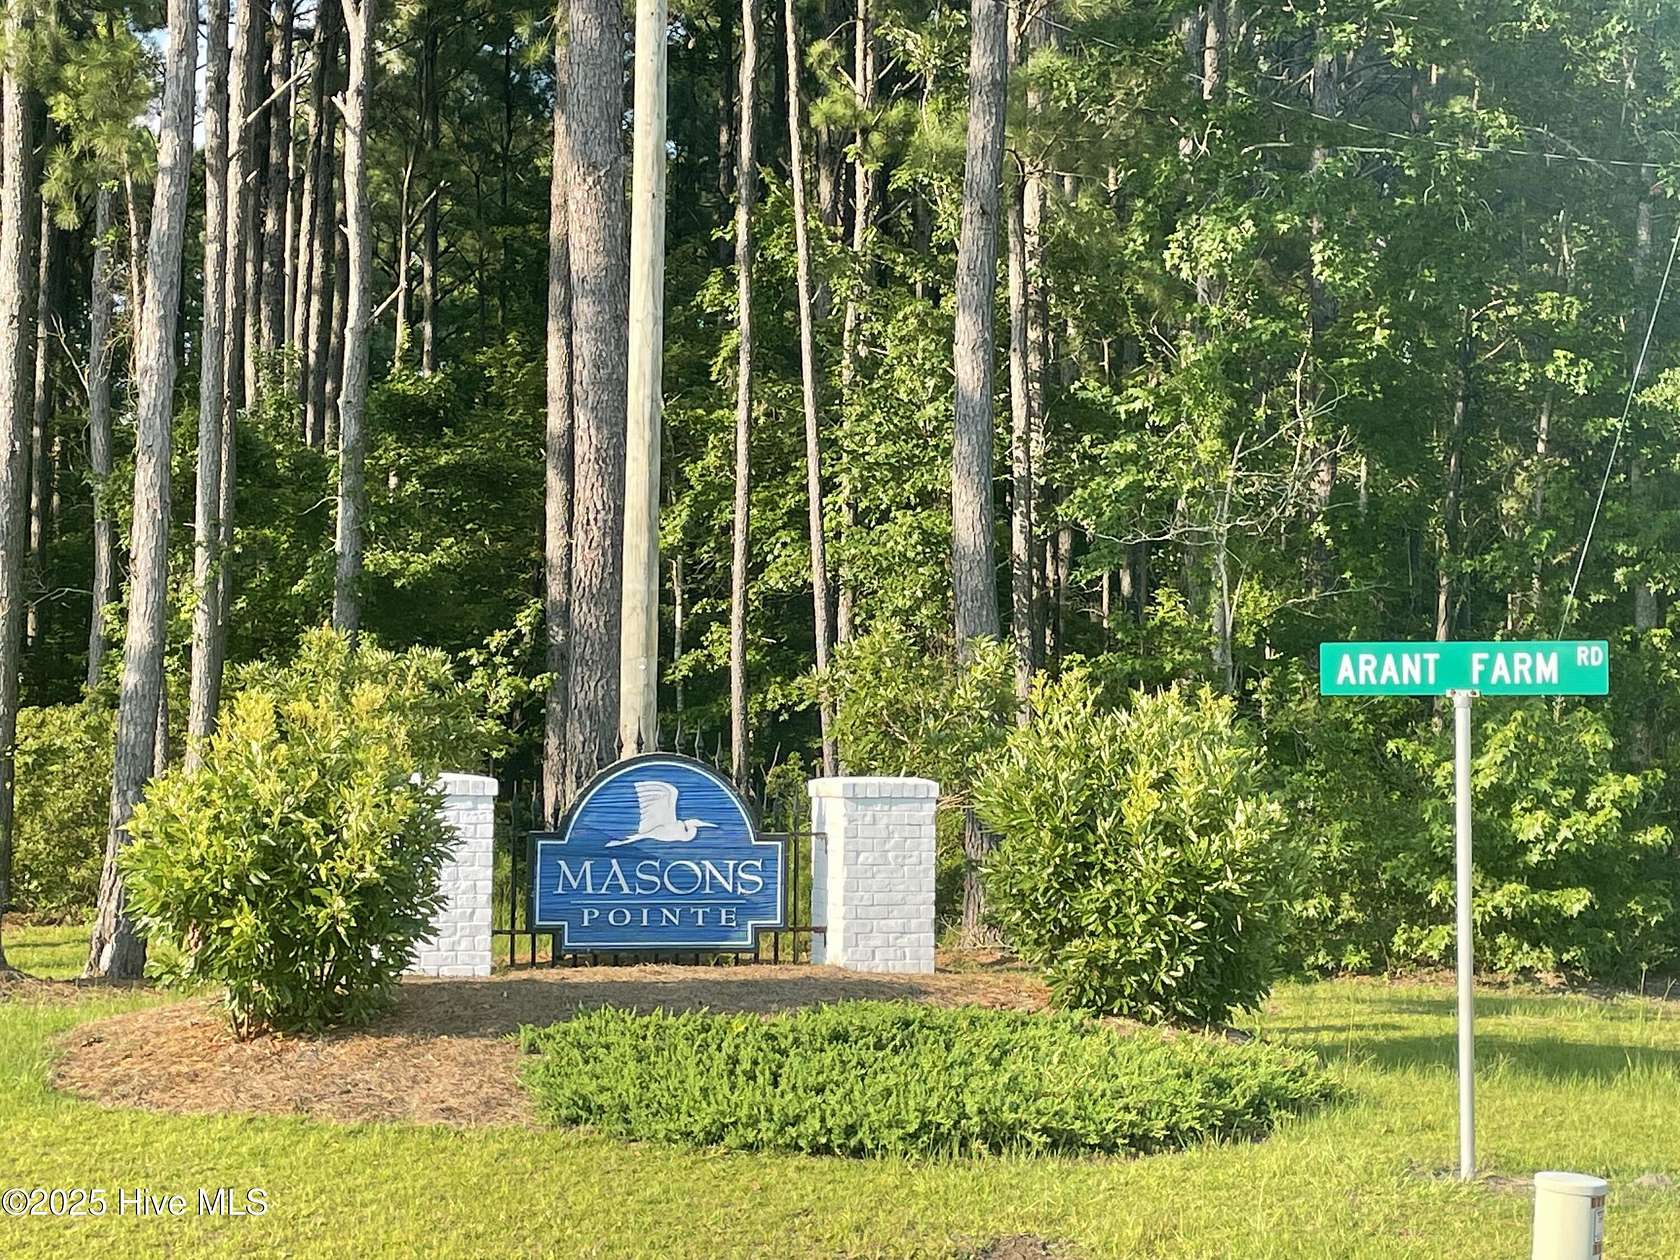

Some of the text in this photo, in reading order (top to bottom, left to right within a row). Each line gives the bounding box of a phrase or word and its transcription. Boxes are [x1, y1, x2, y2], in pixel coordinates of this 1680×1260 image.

[1336, 646, 1604, 685] ARANT FARM RD
[552, 858, 764, 896] MASONS
[580, 907, 739, 928] POINTE
